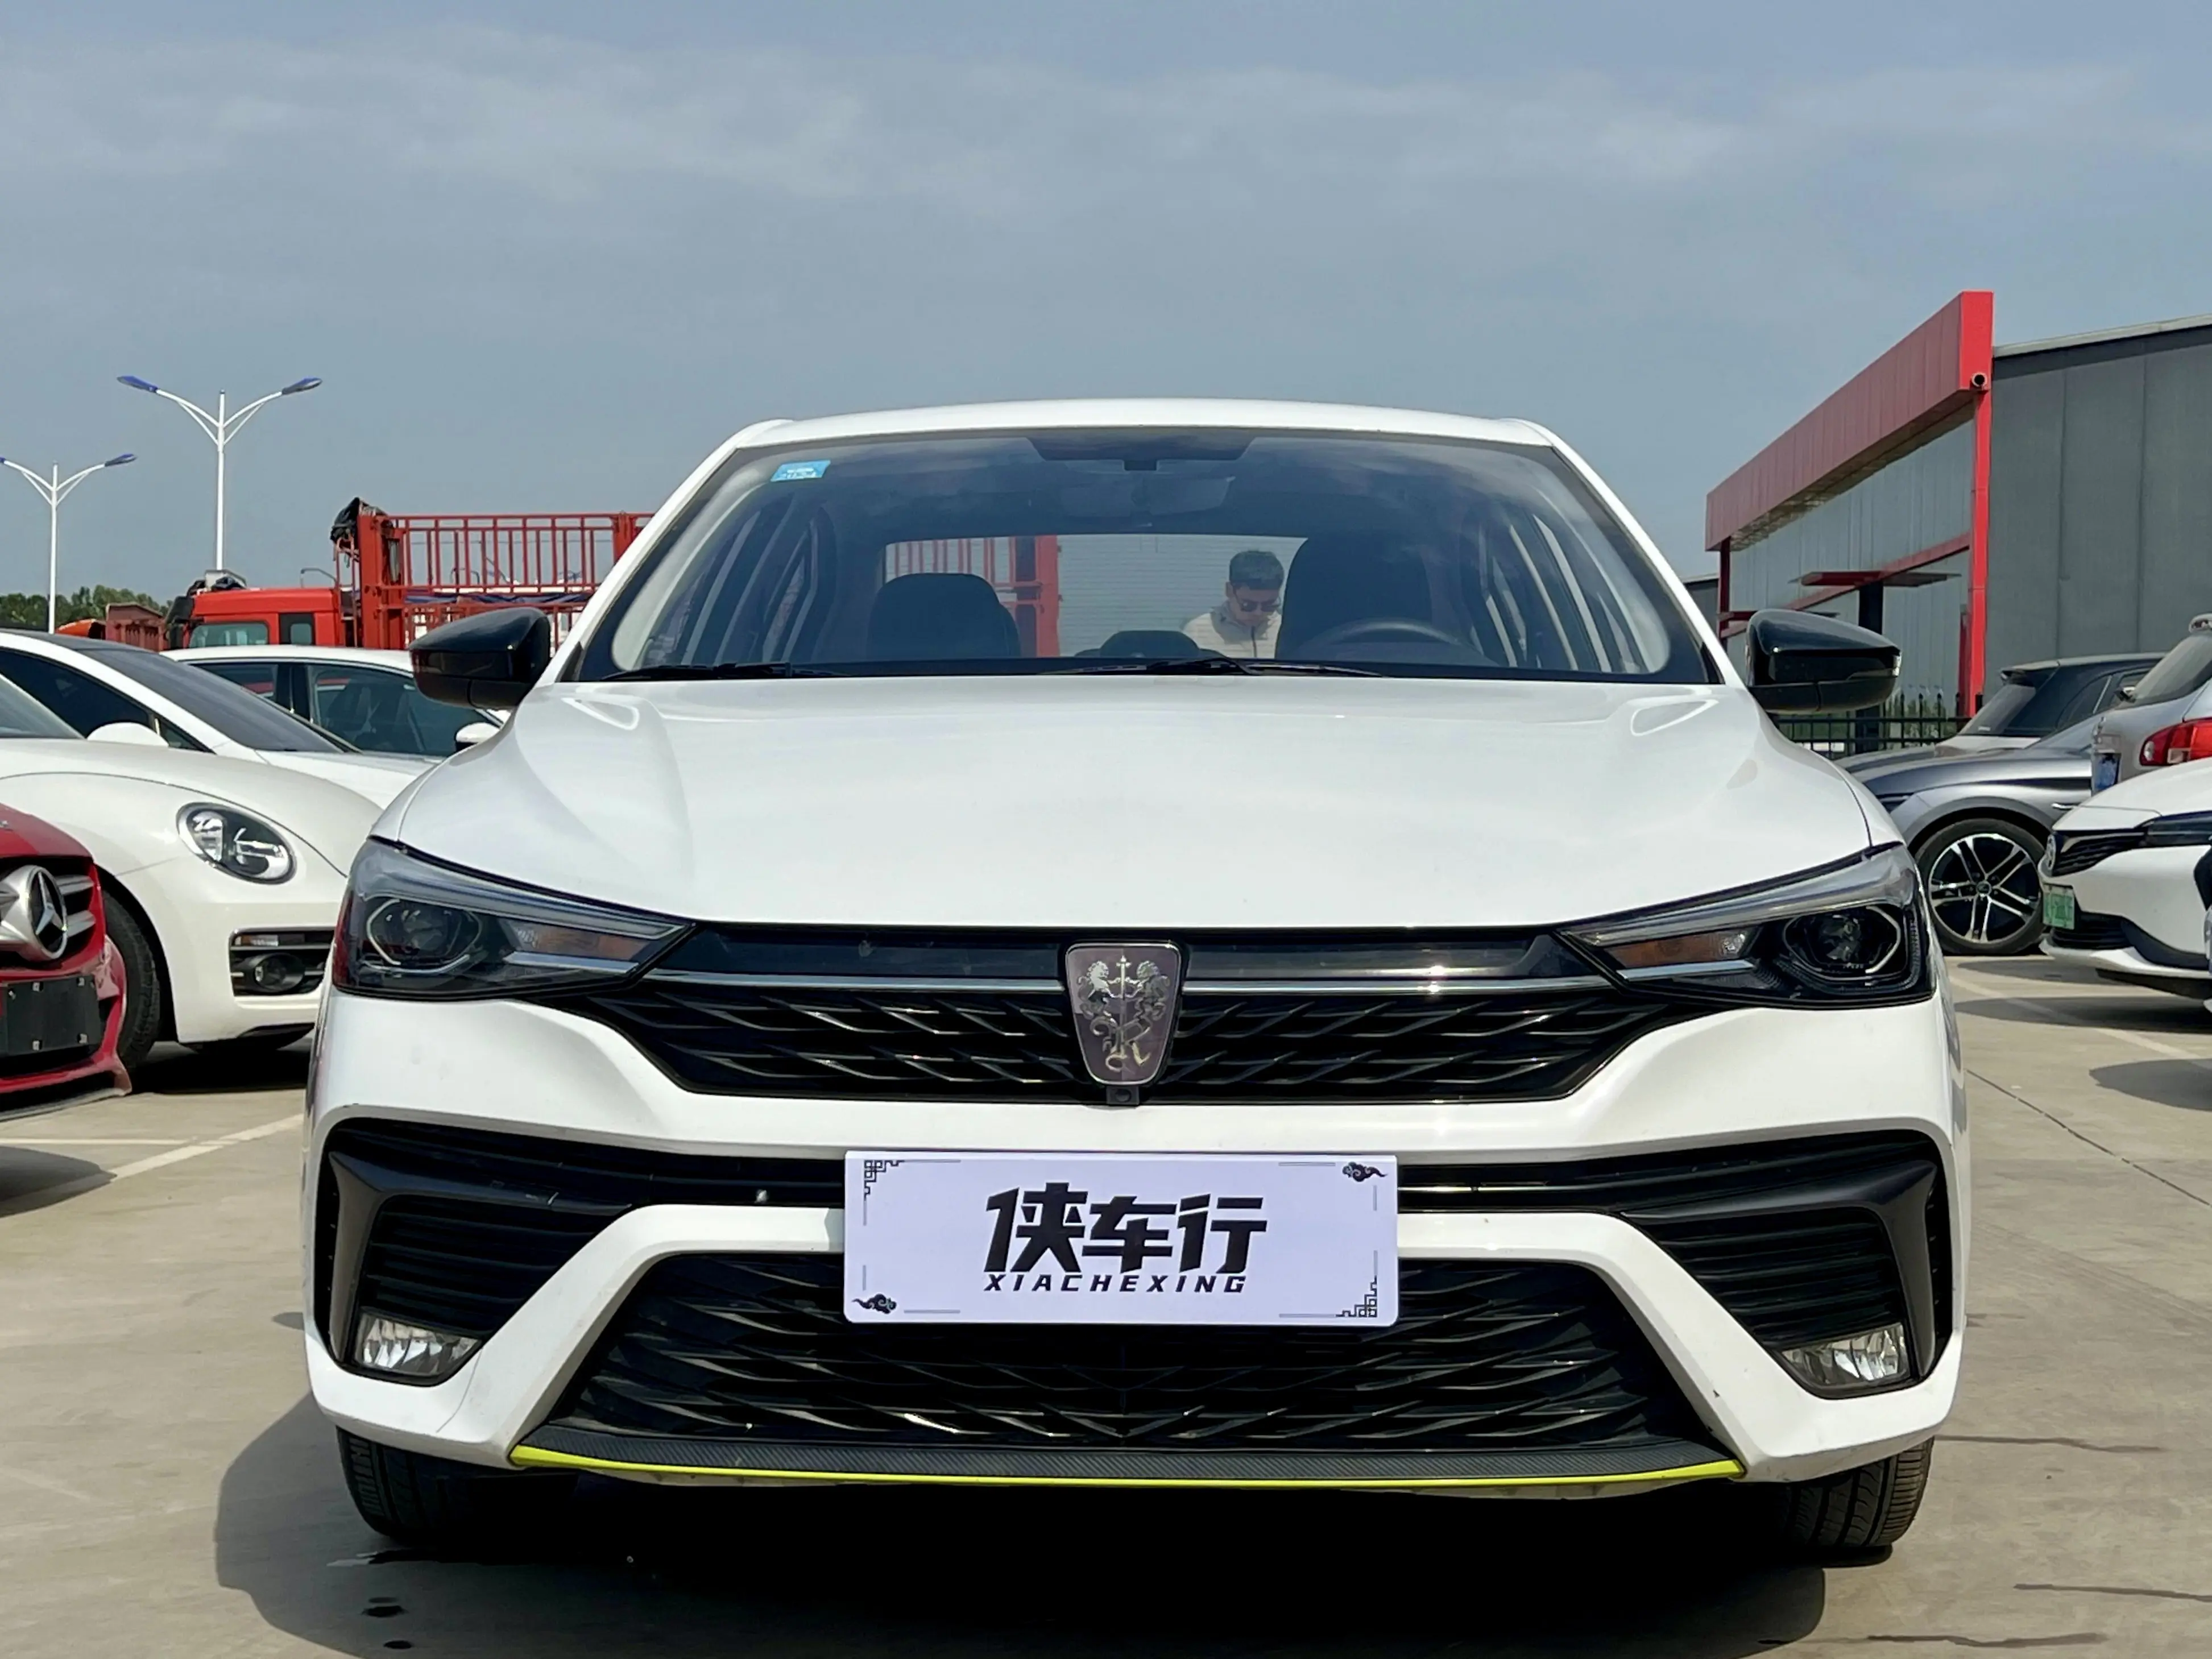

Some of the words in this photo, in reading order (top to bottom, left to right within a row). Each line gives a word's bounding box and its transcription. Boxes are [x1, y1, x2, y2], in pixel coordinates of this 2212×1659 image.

[984, 1182, 1267, 1274] 侠车行
[984, 1274, 1246, 1293] XIACHEXING
